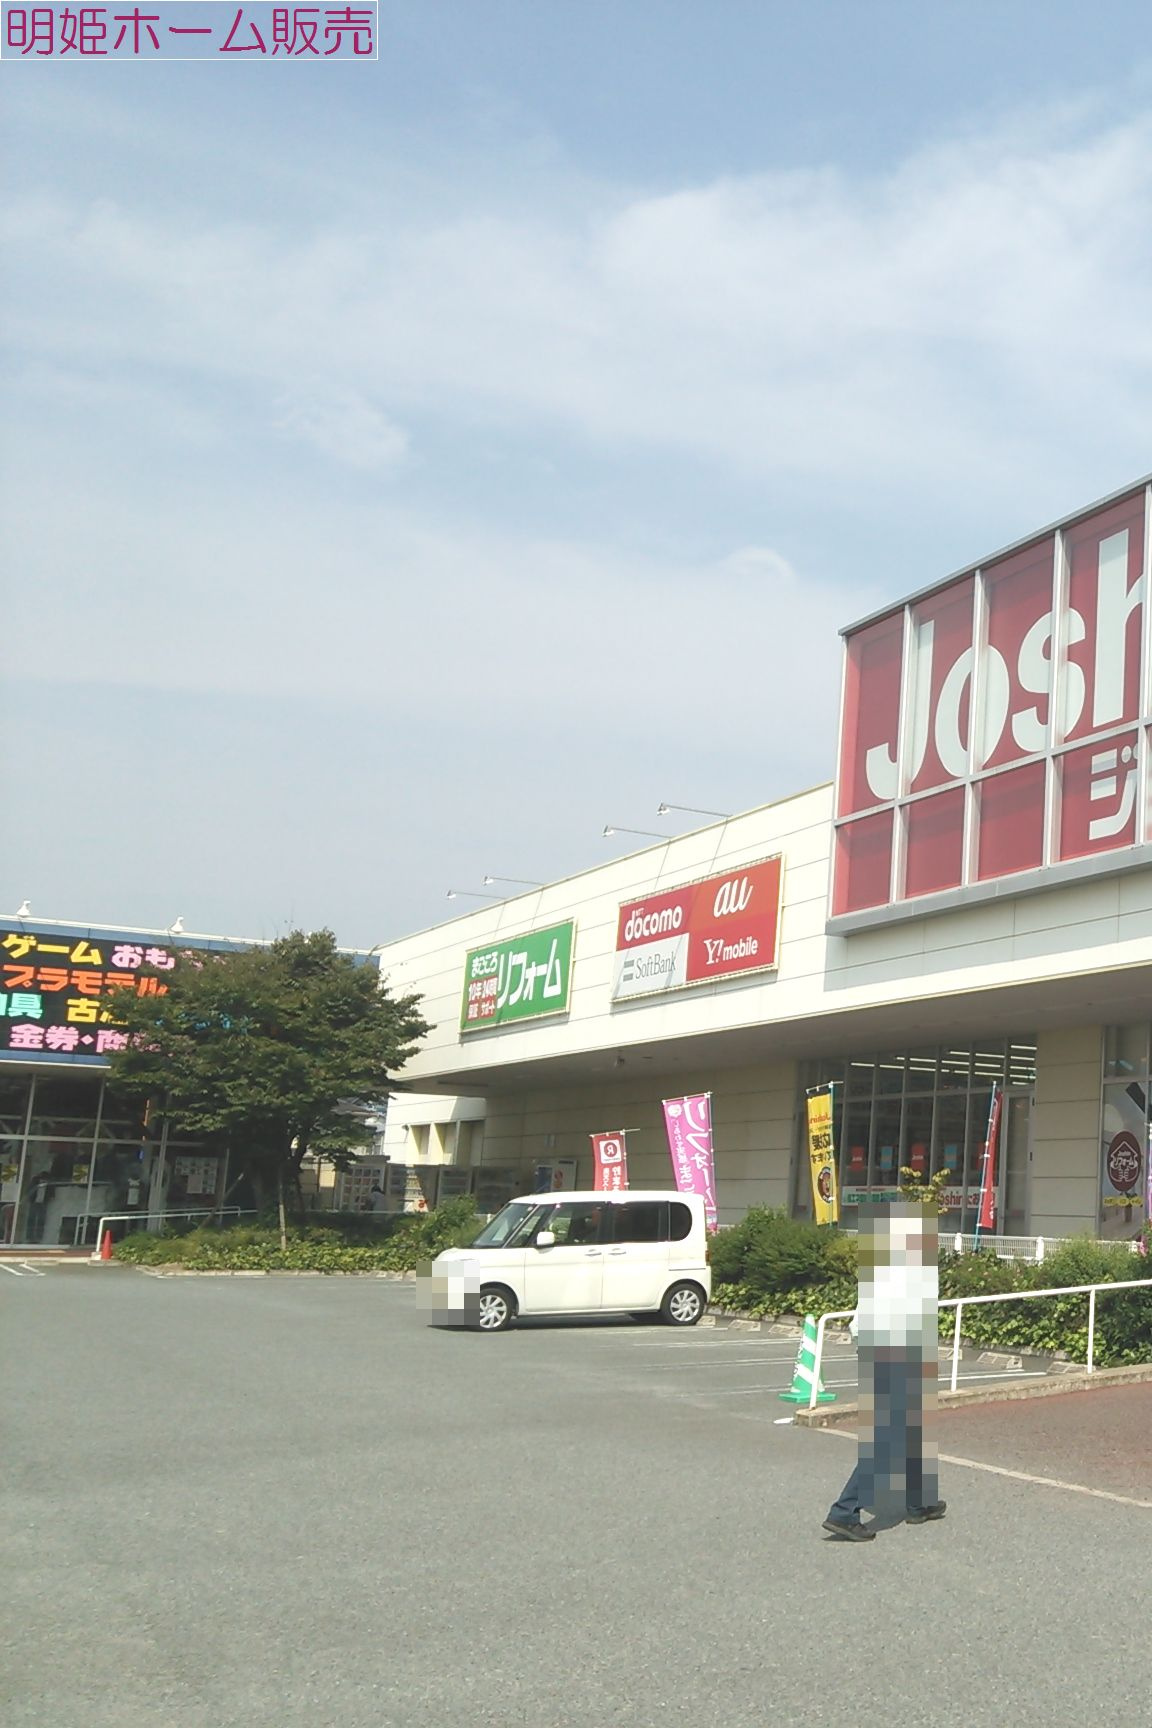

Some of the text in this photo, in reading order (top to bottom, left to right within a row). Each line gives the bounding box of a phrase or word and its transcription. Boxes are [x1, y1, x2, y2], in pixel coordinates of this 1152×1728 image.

[713, 877, 753, 918] au
[624, 906, 682, 942] docomo
[2, 934, 103, 966] ゲーム
[635, 952, 676, 979] SoftBank
[704, 936, 759, 965] Y!mobile
[497, 939, 561, 1008] リフォーム
